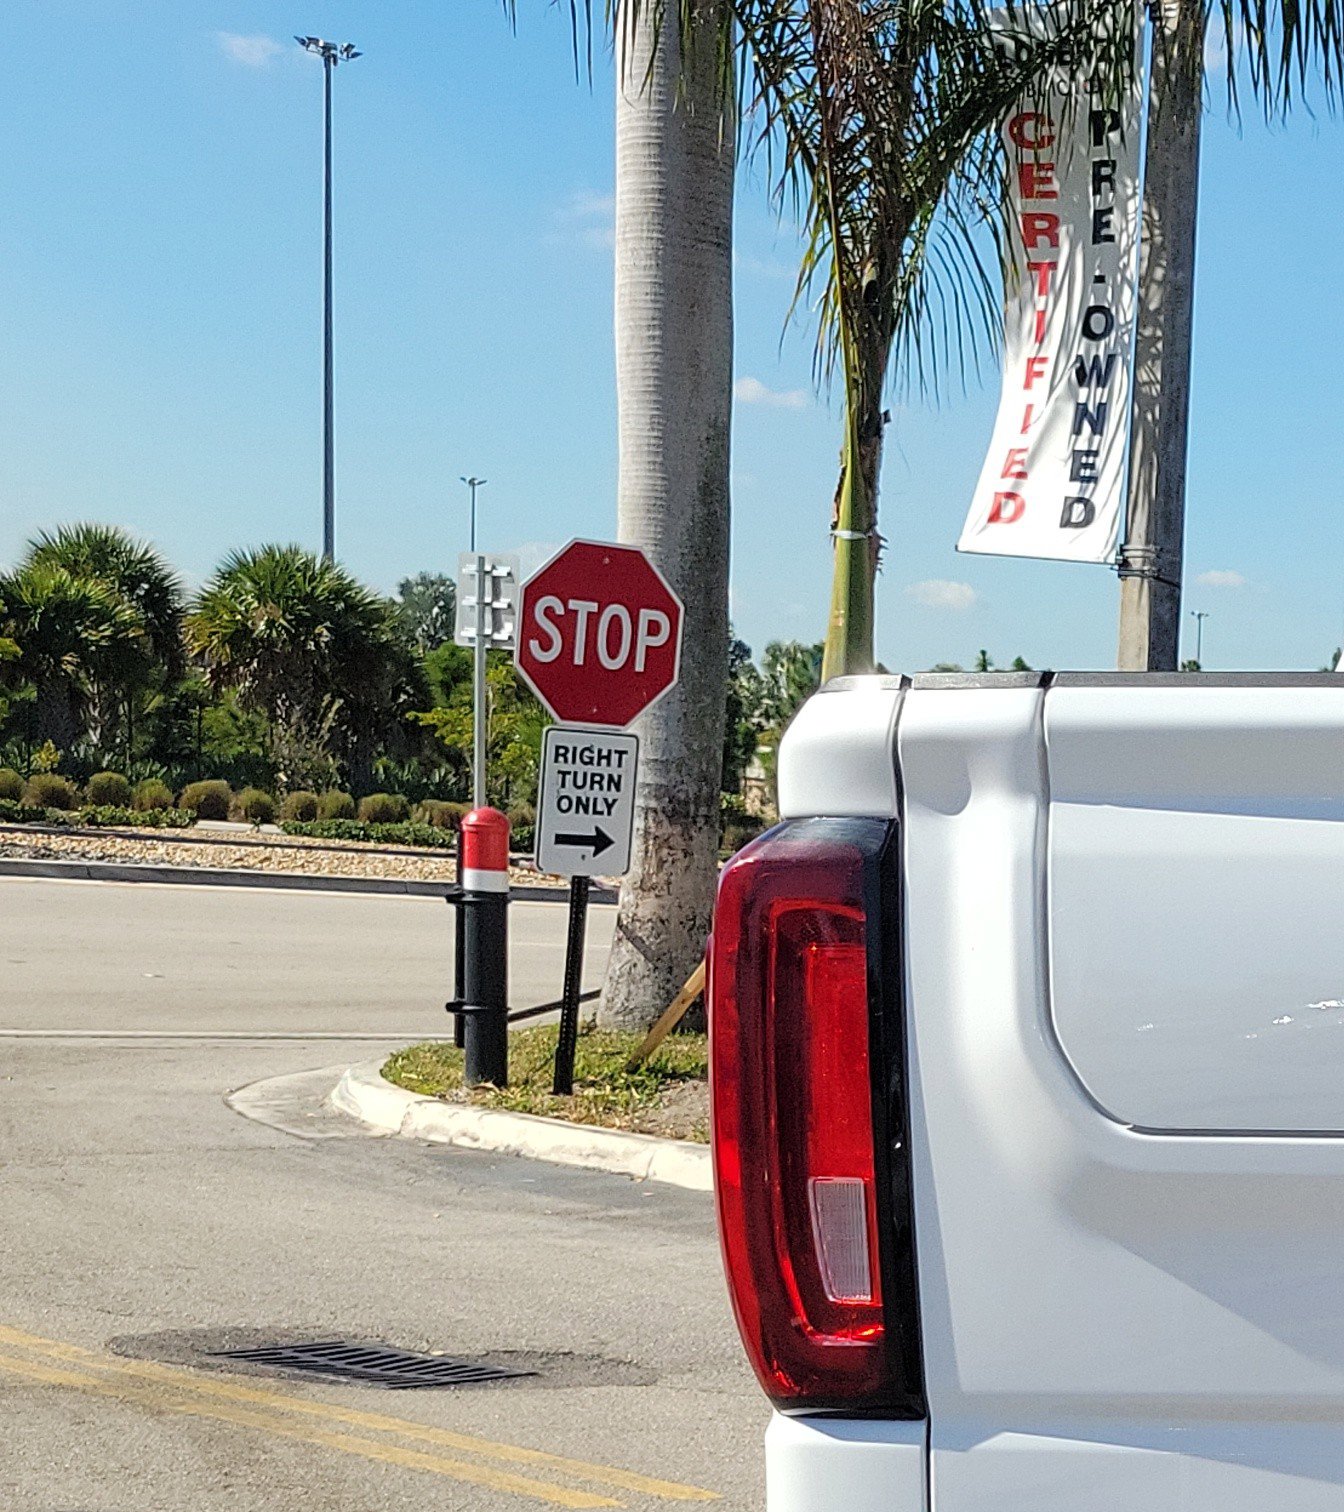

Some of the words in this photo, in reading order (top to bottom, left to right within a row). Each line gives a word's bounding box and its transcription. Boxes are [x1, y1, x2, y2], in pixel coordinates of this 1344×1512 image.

[987, 112, 1060, 524] CERTIFIED
[1059, 109, 1121, 529] PRE-OWNED
[529, 595, 671, 673] STOP
[553, 745, 628, 768] RIGHT
[557, 770, 622, 792] TURN
[556, 795, 618, 816] ONLY
